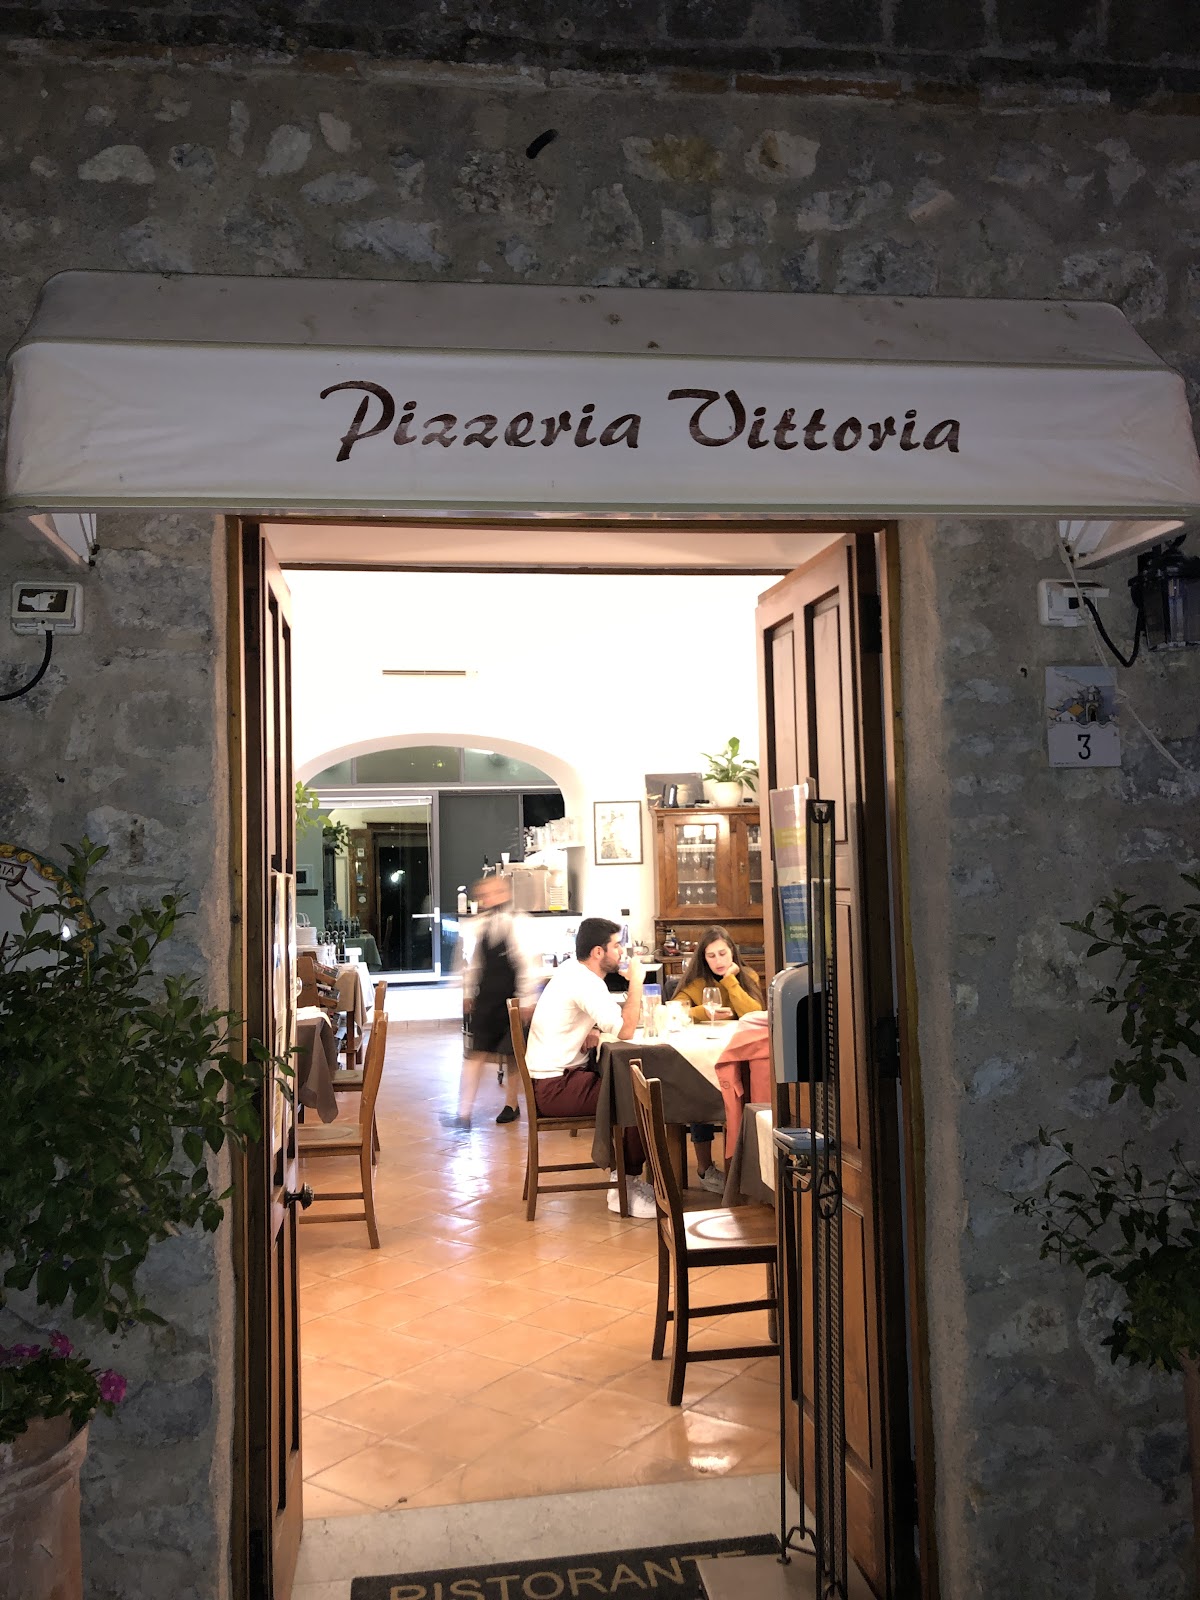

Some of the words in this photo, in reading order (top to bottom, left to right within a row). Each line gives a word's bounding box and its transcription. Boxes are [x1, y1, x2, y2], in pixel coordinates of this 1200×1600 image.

[319, 380, 640, 462] Pizzeria
[667, 388, 961, 453] Vittoria
[1077, 733, 1092, 760] 3
[0, 864, 15, 877] IA
[390, 1549, 746, 1600] RISTORAN
